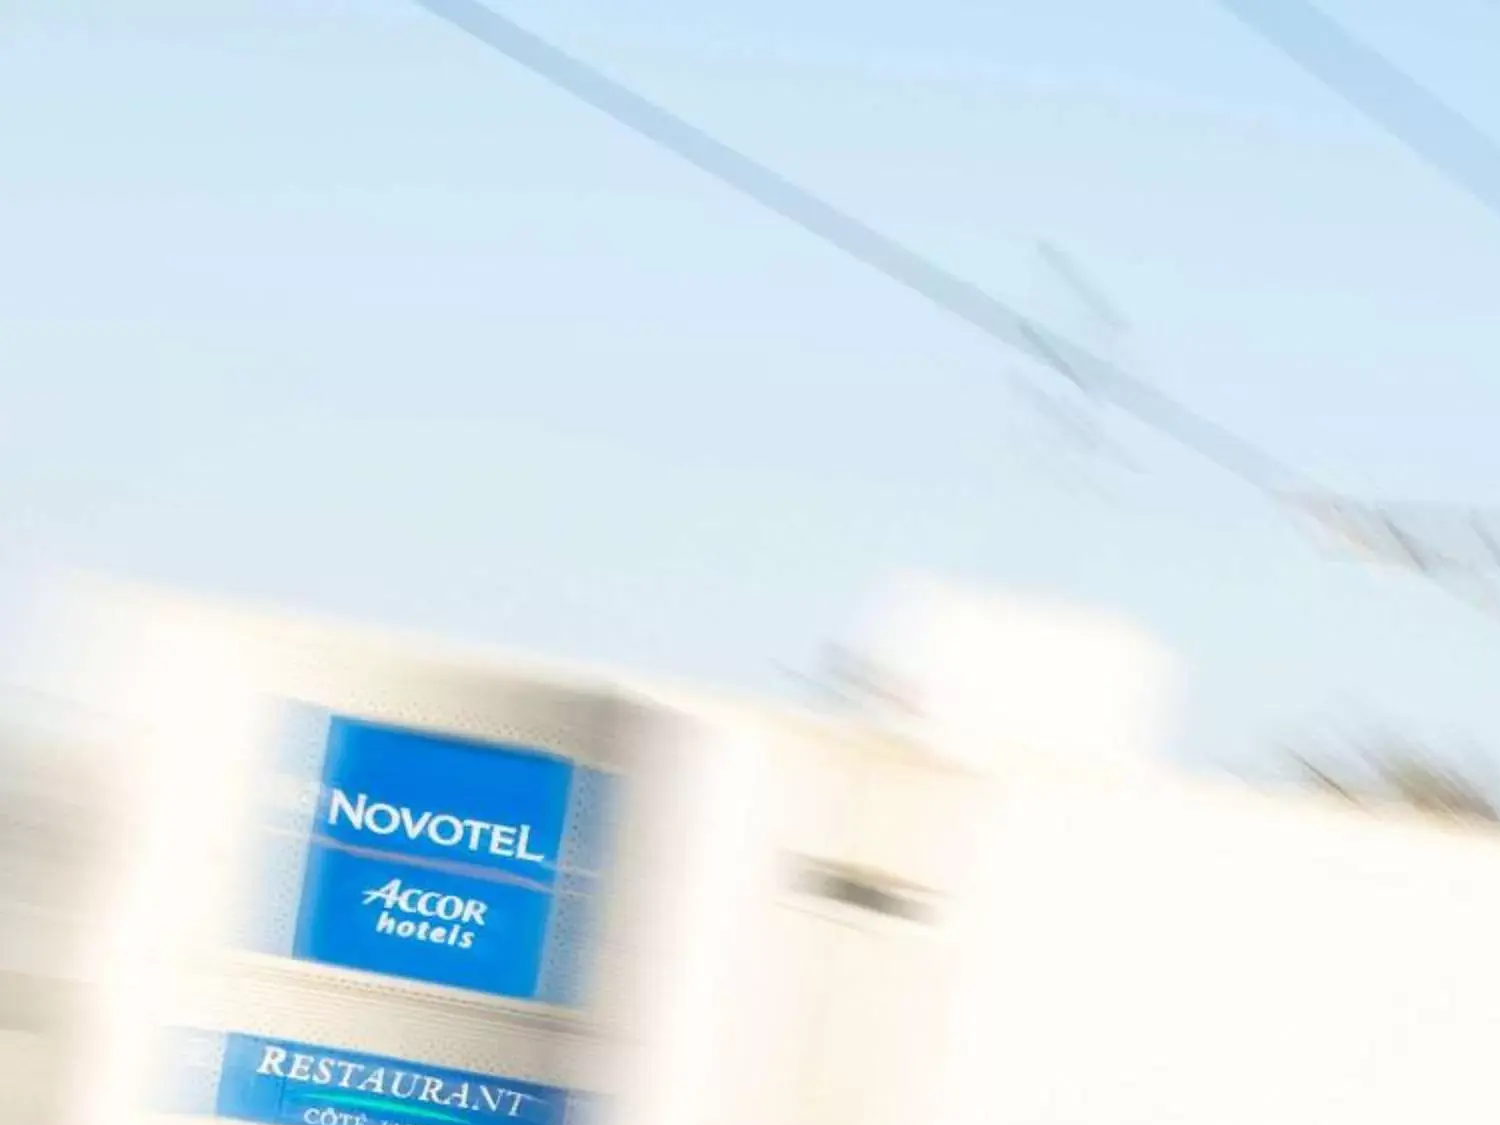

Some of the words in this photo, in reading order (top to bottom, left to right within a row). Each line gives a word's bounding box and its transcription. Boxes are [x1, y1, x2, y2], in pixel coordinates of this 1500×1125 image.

[328, 787, 545, 863] NOVOTEL
[361, 877, 489, 926] ACCOR
[375, 911, 476, 949] hotels
[256, 1045, 529, 1117] RESTAURANT
